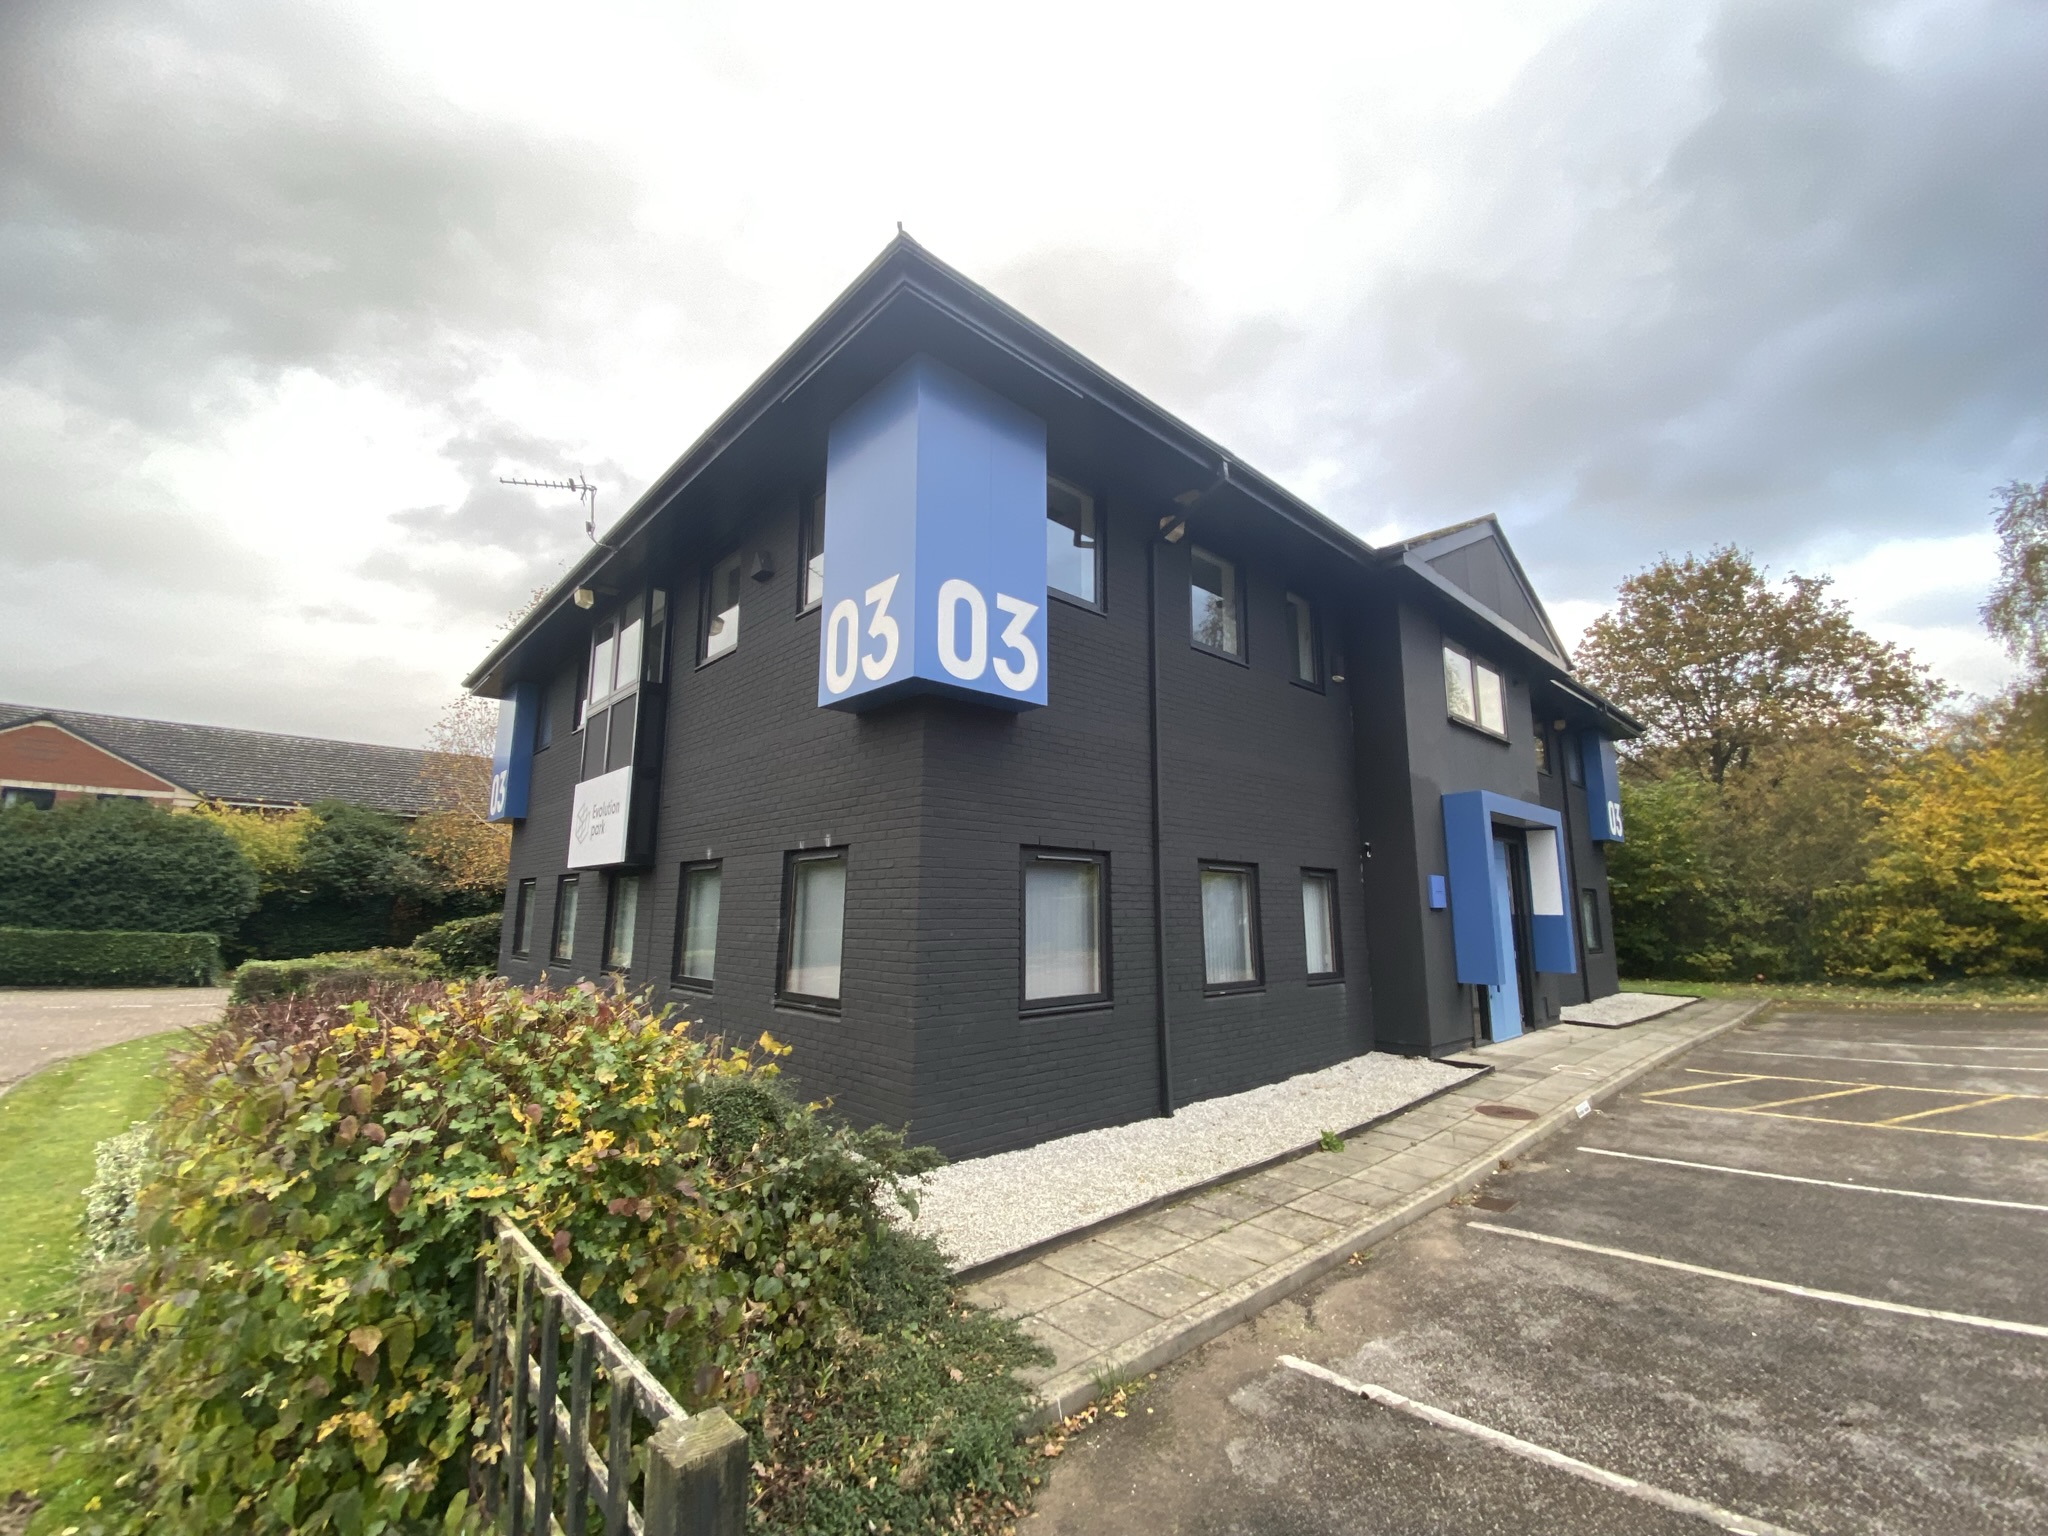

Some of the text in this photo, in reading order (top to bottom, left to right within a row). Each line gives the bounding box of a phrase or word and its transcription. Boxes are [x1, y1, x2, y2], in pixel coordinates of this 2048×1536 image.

[826, 573, 900, 695] 03
[937, 578, 1039, 692] 03
[490, 769, 508, 815] 03
[592, 800, 620, 819] Evolution
[590, 820, 606, 841] park
[1607, 800, 1623, 837] 03
